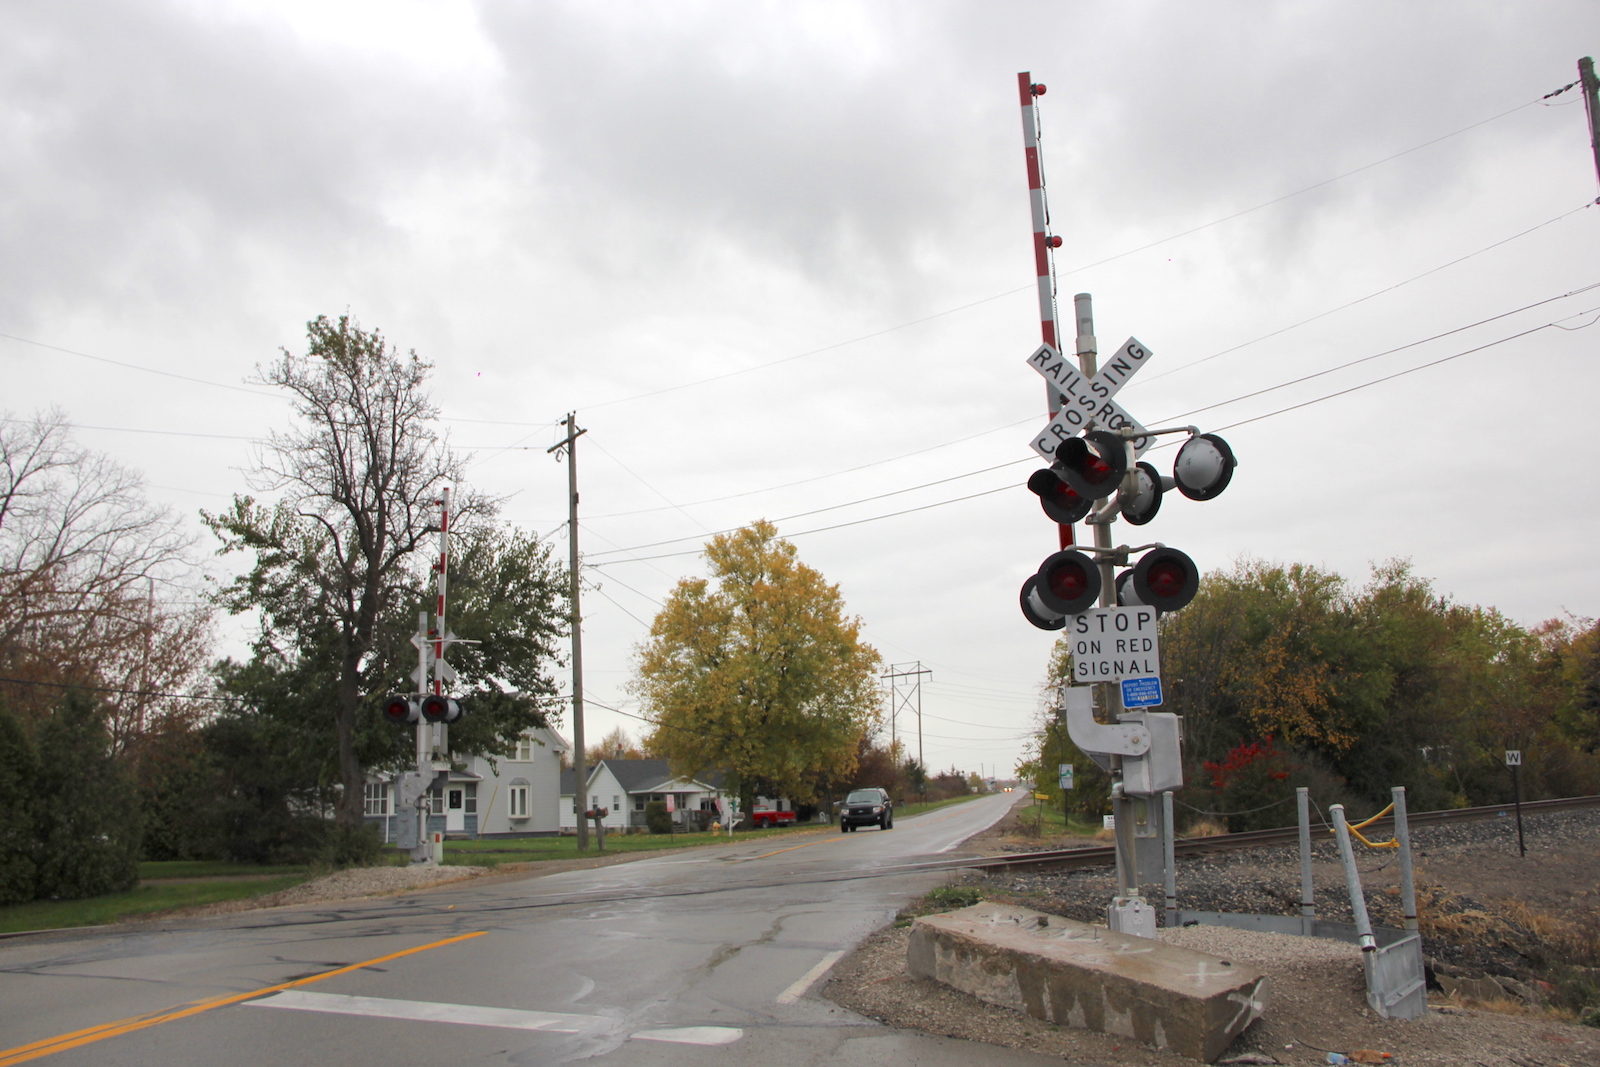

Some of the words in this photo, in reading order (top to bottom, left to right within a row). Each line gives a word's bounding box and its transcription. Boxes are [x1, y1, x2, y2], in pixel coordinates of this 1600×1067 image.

[1038, 343, 1145, 454] CROSSING
[1076, 612, 1151, 633] STOP
[1077, 640, 1101, 655] ON
[1116, 638, 1152, 653] RED
[1079, 659, 1154, 676] SIGNAL
[1507, 752, 1519, 763] W
